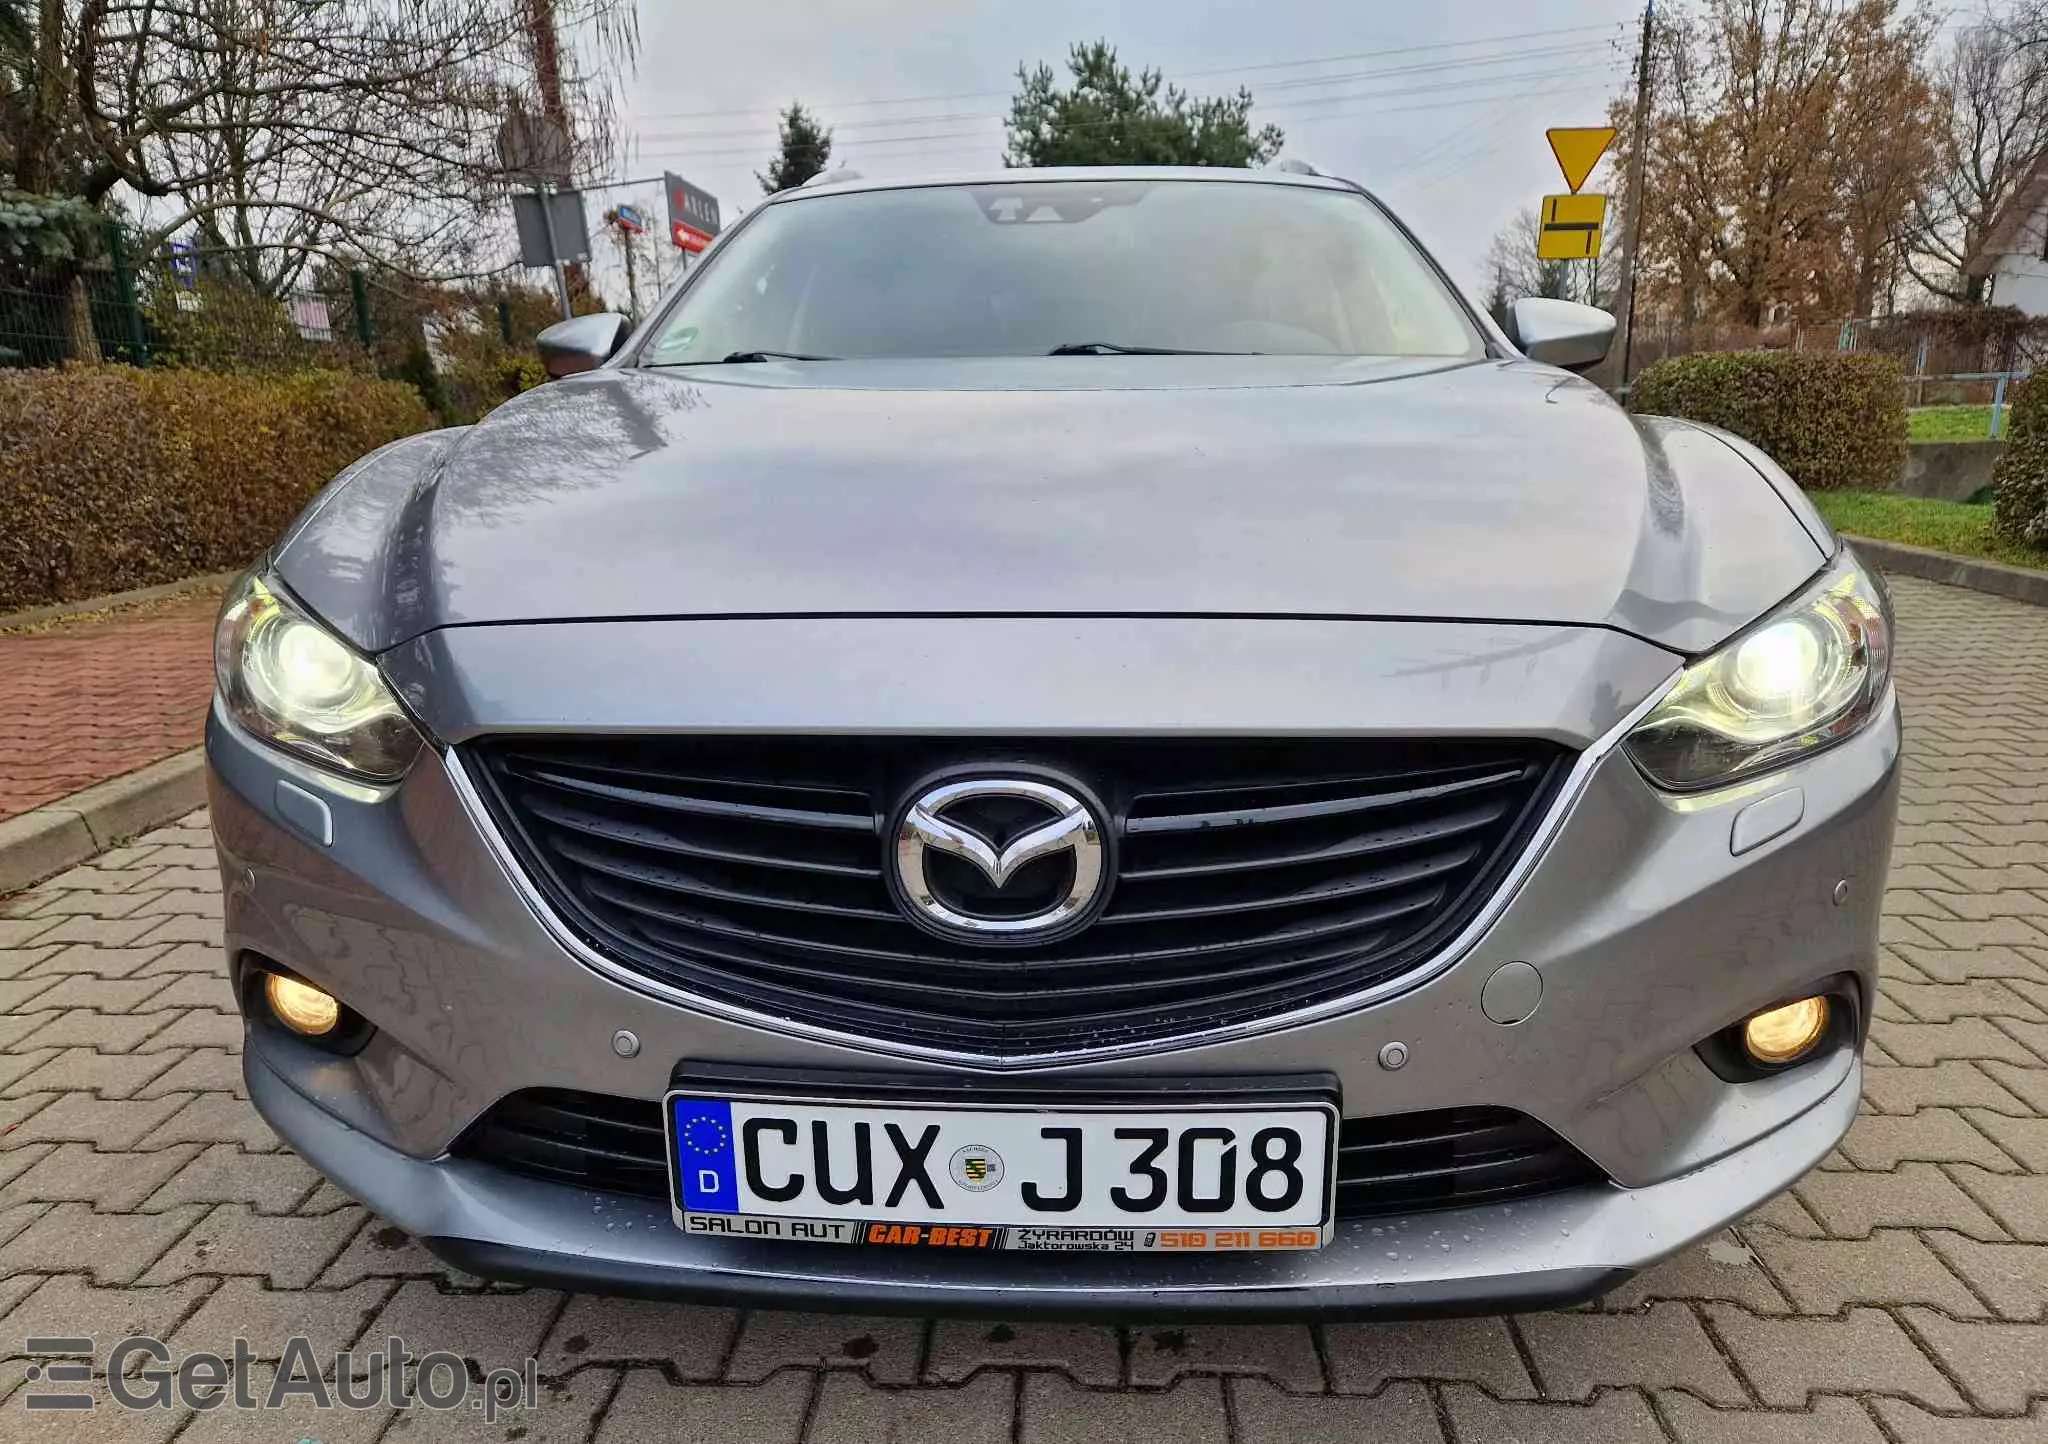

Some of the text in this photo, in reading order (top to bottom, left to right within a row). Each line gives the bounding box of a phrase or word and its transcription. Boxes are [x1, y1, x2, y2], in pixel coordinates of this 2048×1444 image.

[743, 1117, 1304, 1212] CUX J 308
[698, 1169, 720, 1194] D
[689, 1216, 846, 1239] SALON AUT
[867, 1224, 993, 1248] CAR-BEST
[1017, 1241, 1135, 1251] Jaktorowska 24
[1215, 1231, 1251, 1248] 211
